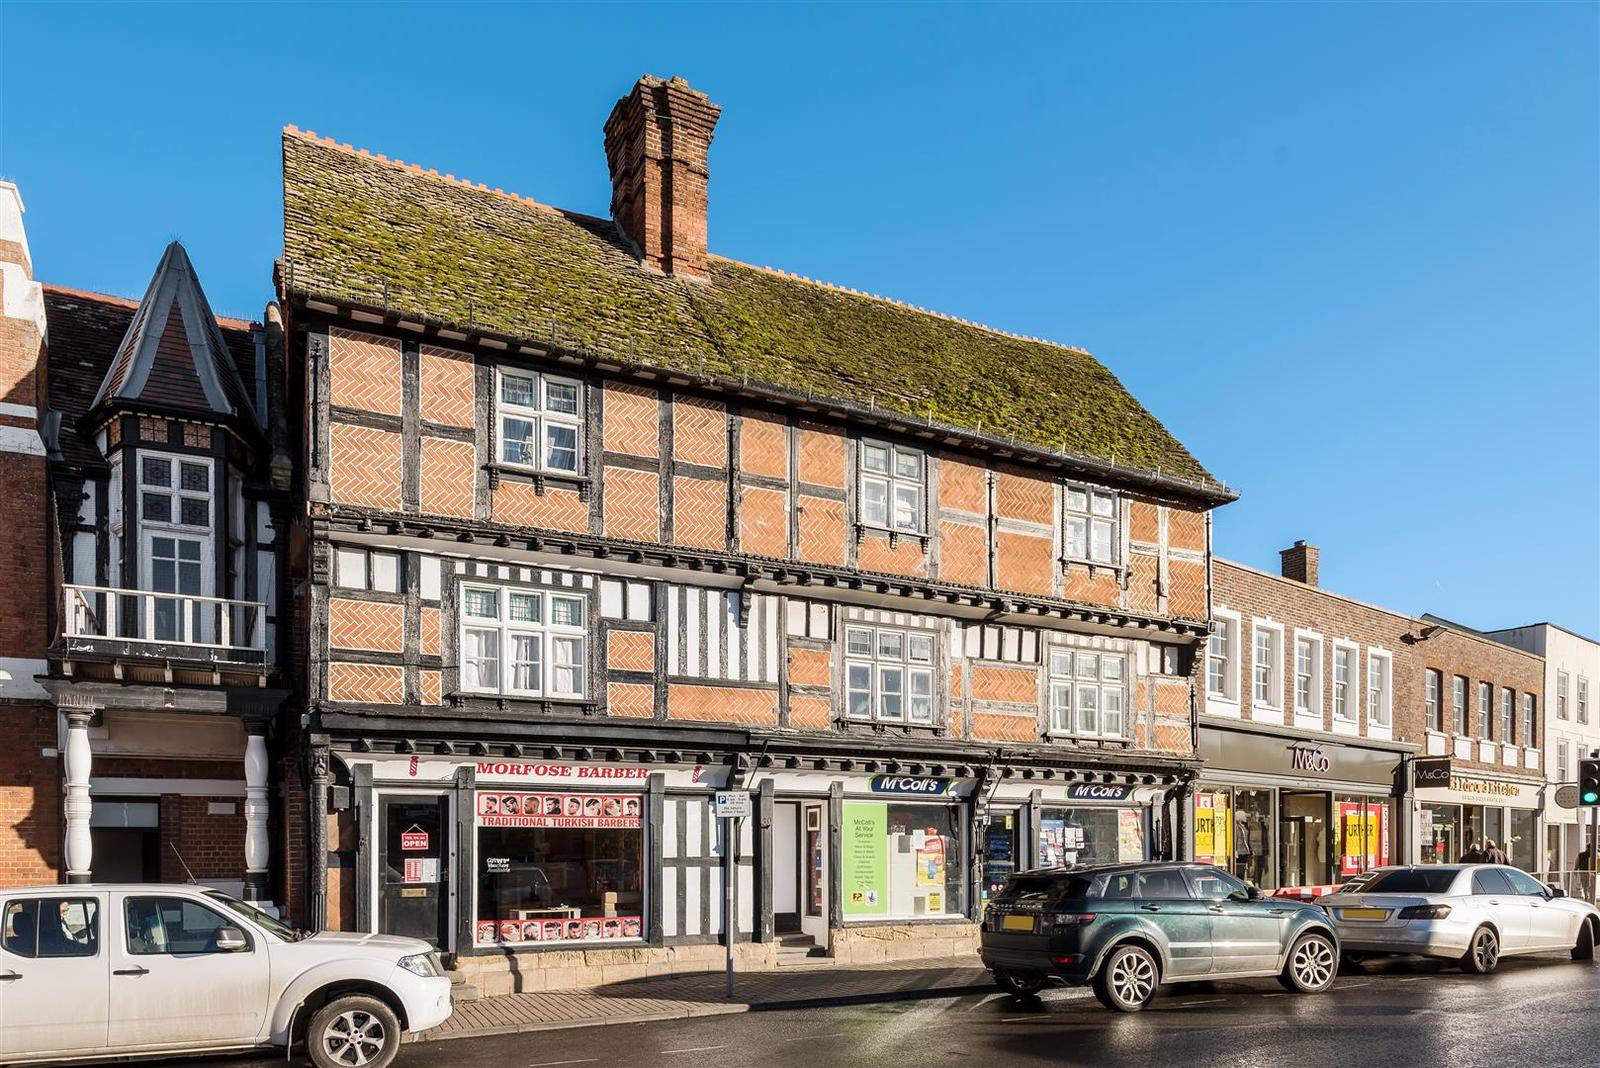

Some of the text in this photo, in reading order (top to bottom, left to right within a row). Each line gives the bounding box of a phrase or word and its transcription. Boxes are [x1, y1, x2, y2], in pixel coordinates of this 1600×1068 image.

[1294, 748, 1330, 772] M&Co
[476, 762, 649, 779] MORFOSE BARBER
[1415, 768, 1450, 780] M&Co
[481, 817, 640, 828] TRADITIONAL TURKISH BARBERS
